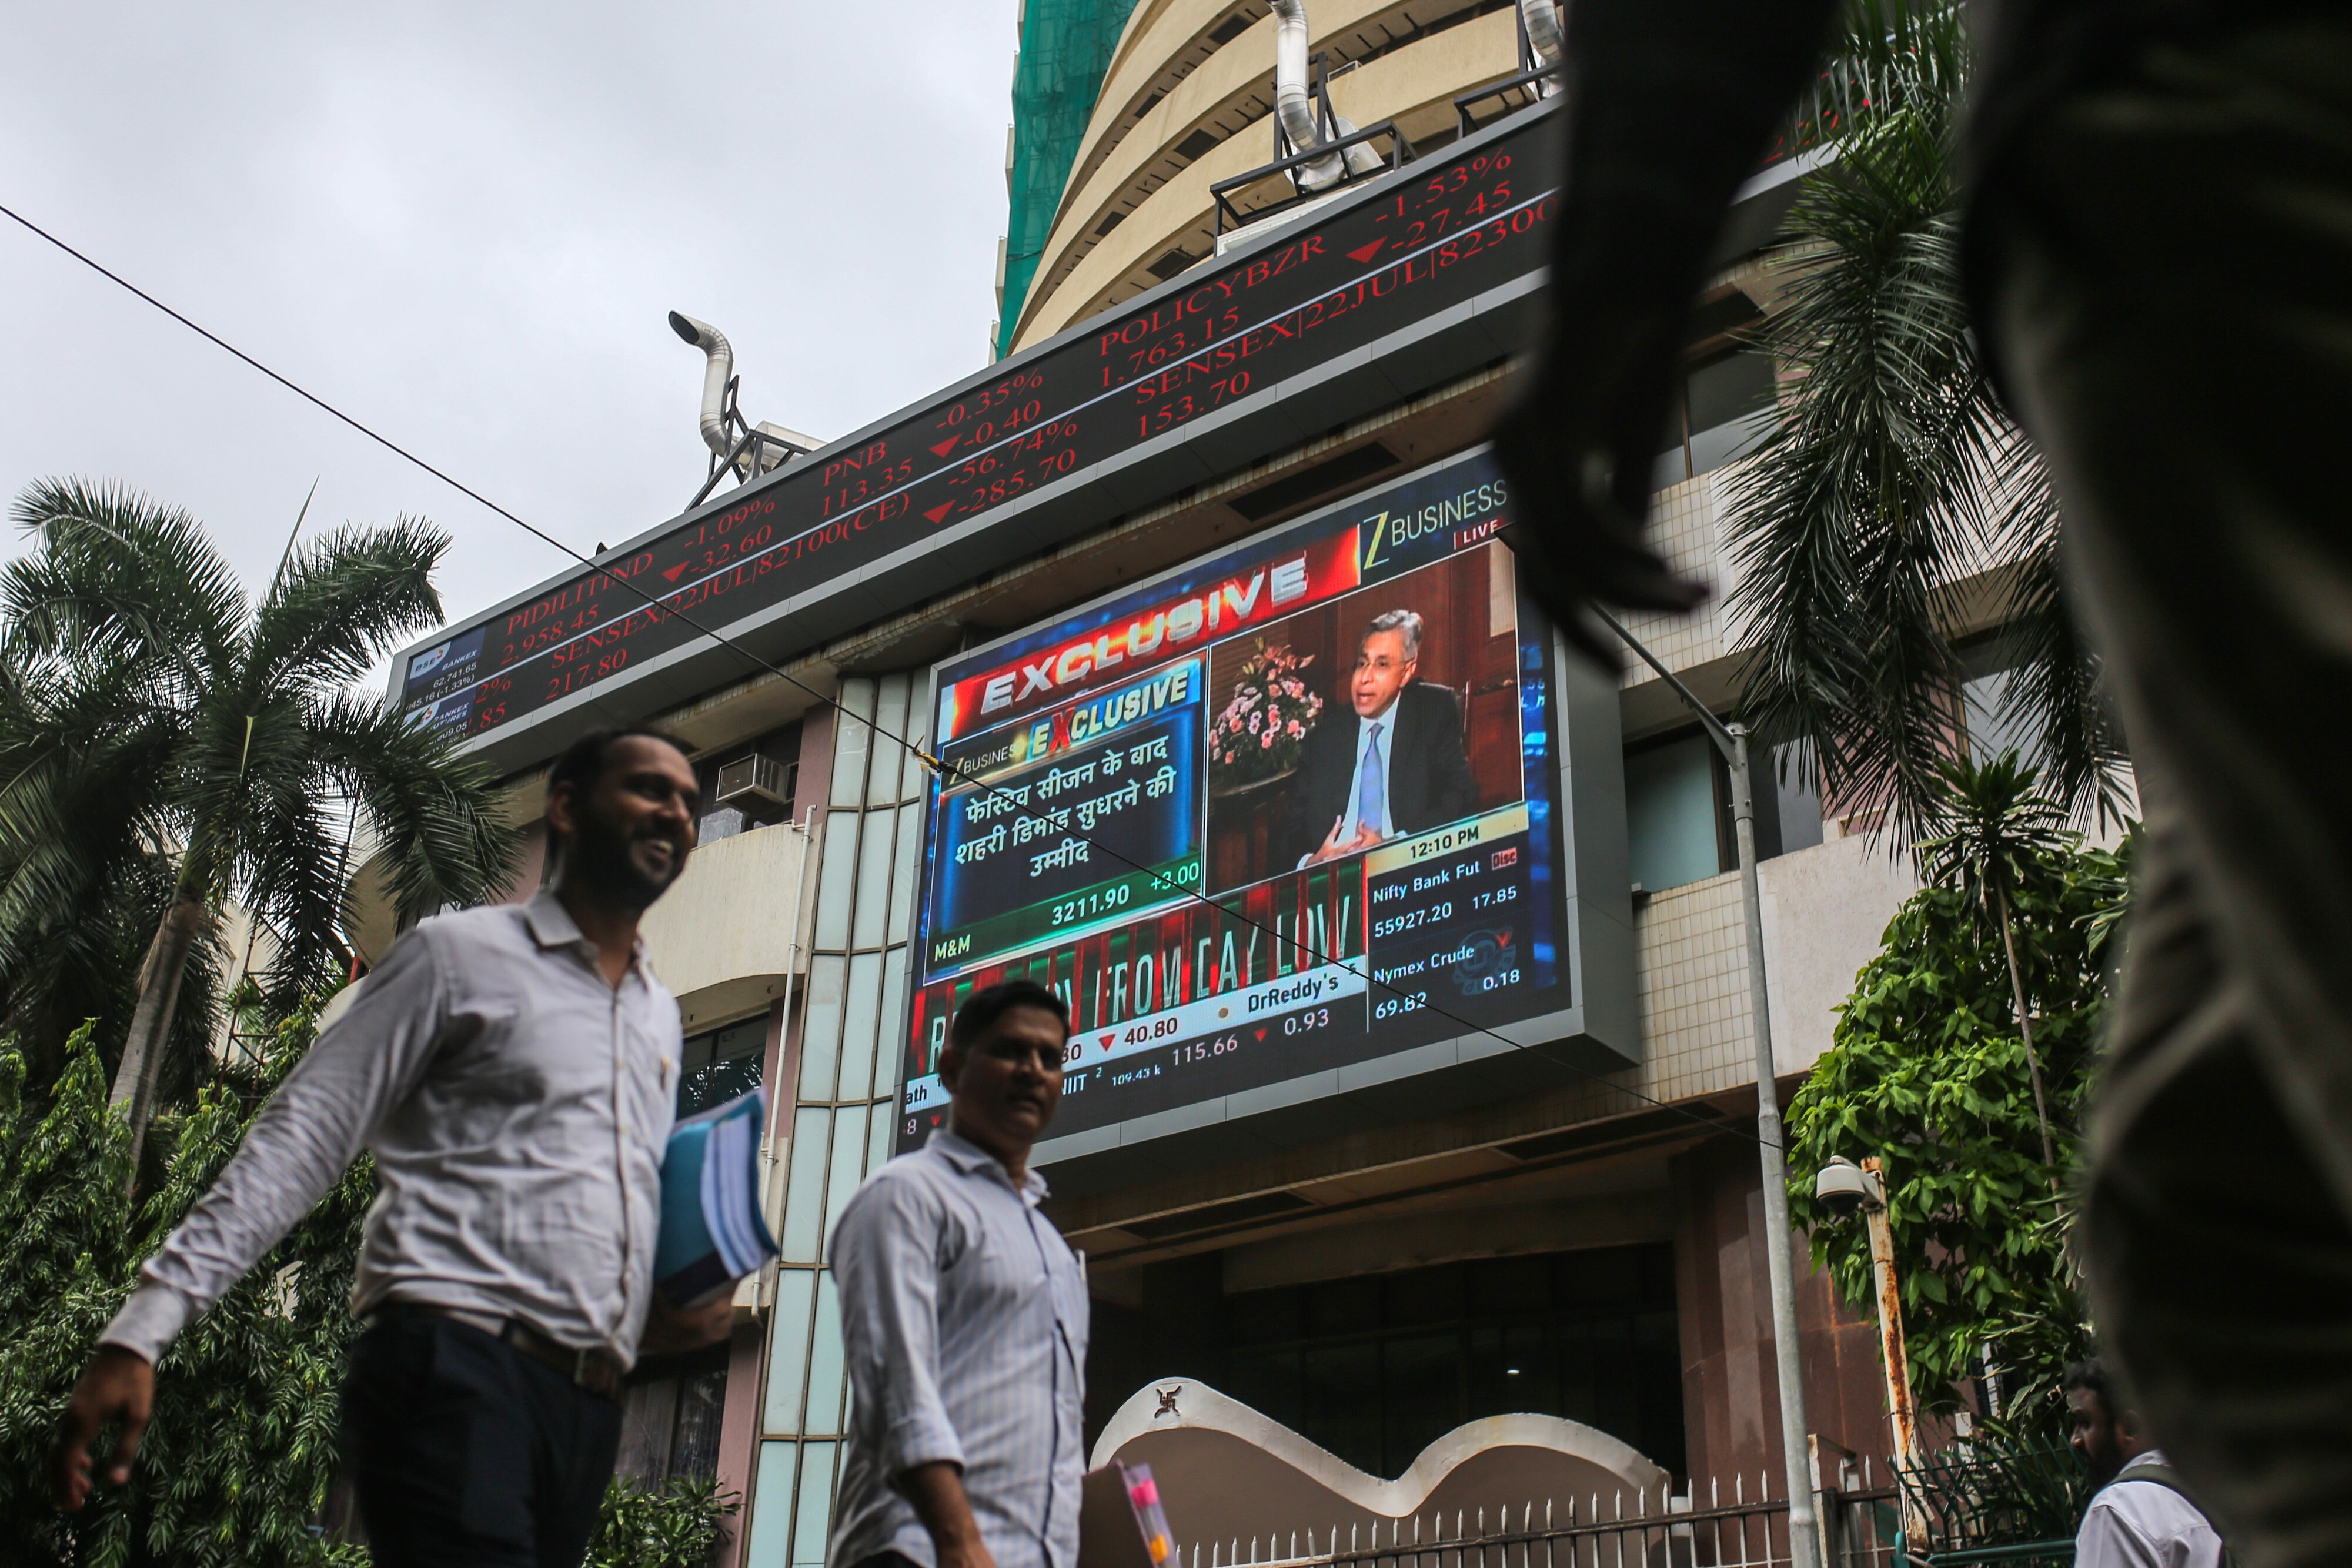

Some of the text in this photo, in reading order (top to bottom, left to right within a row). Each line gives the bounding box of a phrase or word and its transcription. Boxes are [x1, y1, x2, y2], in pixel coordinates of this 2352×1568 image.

[1376, 147, 1511, 222] -1.53%
[1391, 180, 1510, 249] -27.45
[1100, 236, 1327, 356] POLICYBZR
[1101, 306, 1239, 388] 1,763.15
[937, 368, 1043, 429] -0.35%
[964, 400, 1041, 446] -0.40
[1139, 372, 1250, 438] 153.70
[824, 442, 886, 487] PNB
[948, 416, 1077, 486] -56.74%
[824, 457, 913, 516] 113.35
[958, 449, 1075, 513] -285.70
[684, 494, 776, 547] -1.09%
[1392, 479, 1507, 546] BUSINESS
[1464, 520, 1499, 544] LIVE
[690, 524, 771, 572] -32.60
[507, 553, 653, 636] PIDILITIND
[442, 650, 477, 671] BANKEX
[501, 604, 599, 665] 2,958.45
[981, 555, 1308, 714] EXCLUSIVE
[415, 658, 436, 671] BSE
[433, 662, 476, 688] 62,741.65
[437, 674, 475, 698] (-1.33%)
[473, 673, 511, 703] 2%
[545, 648, 627, 700] 217.80
[427, 710, 467, 733] UTURES
[467, 701, 506, 734] .85
[964, 744, 1016, 775] BUSINES
[1031, 671, 1187, 754] EXCLUSIVE
[965, 735, 1169, 823] फेस्टिव सीजन के बाद
[956, 765, 1177, 864] शहरी डिमांड सुधरने की
[1030, 837, 1091, 877] उम्मीद
[1411, 826, 1479, 859] 12:10 PM
[1374, 882, 1408, 904] Nifty
[1414, 869, 1449, 892] Bank
[1456, 861, 1480, 880] Fut
[934, 862, 1200, 962] M&M 3211.90 +3.00
[1375, 885, 1517, 937] 55927.20 17.85
[1374, 945, 1475, 985] Nymex Crude
[1124, 1017, 1178, 1045] 40.80
[1248, 973, 1338, 1014] DrReddy's
[1375, 969, 1520, 1019] 69.82 0.18
[1173, 1034, 1238, 1065] 115.66
[1285, 1009, 1329, 1035] 0.93
